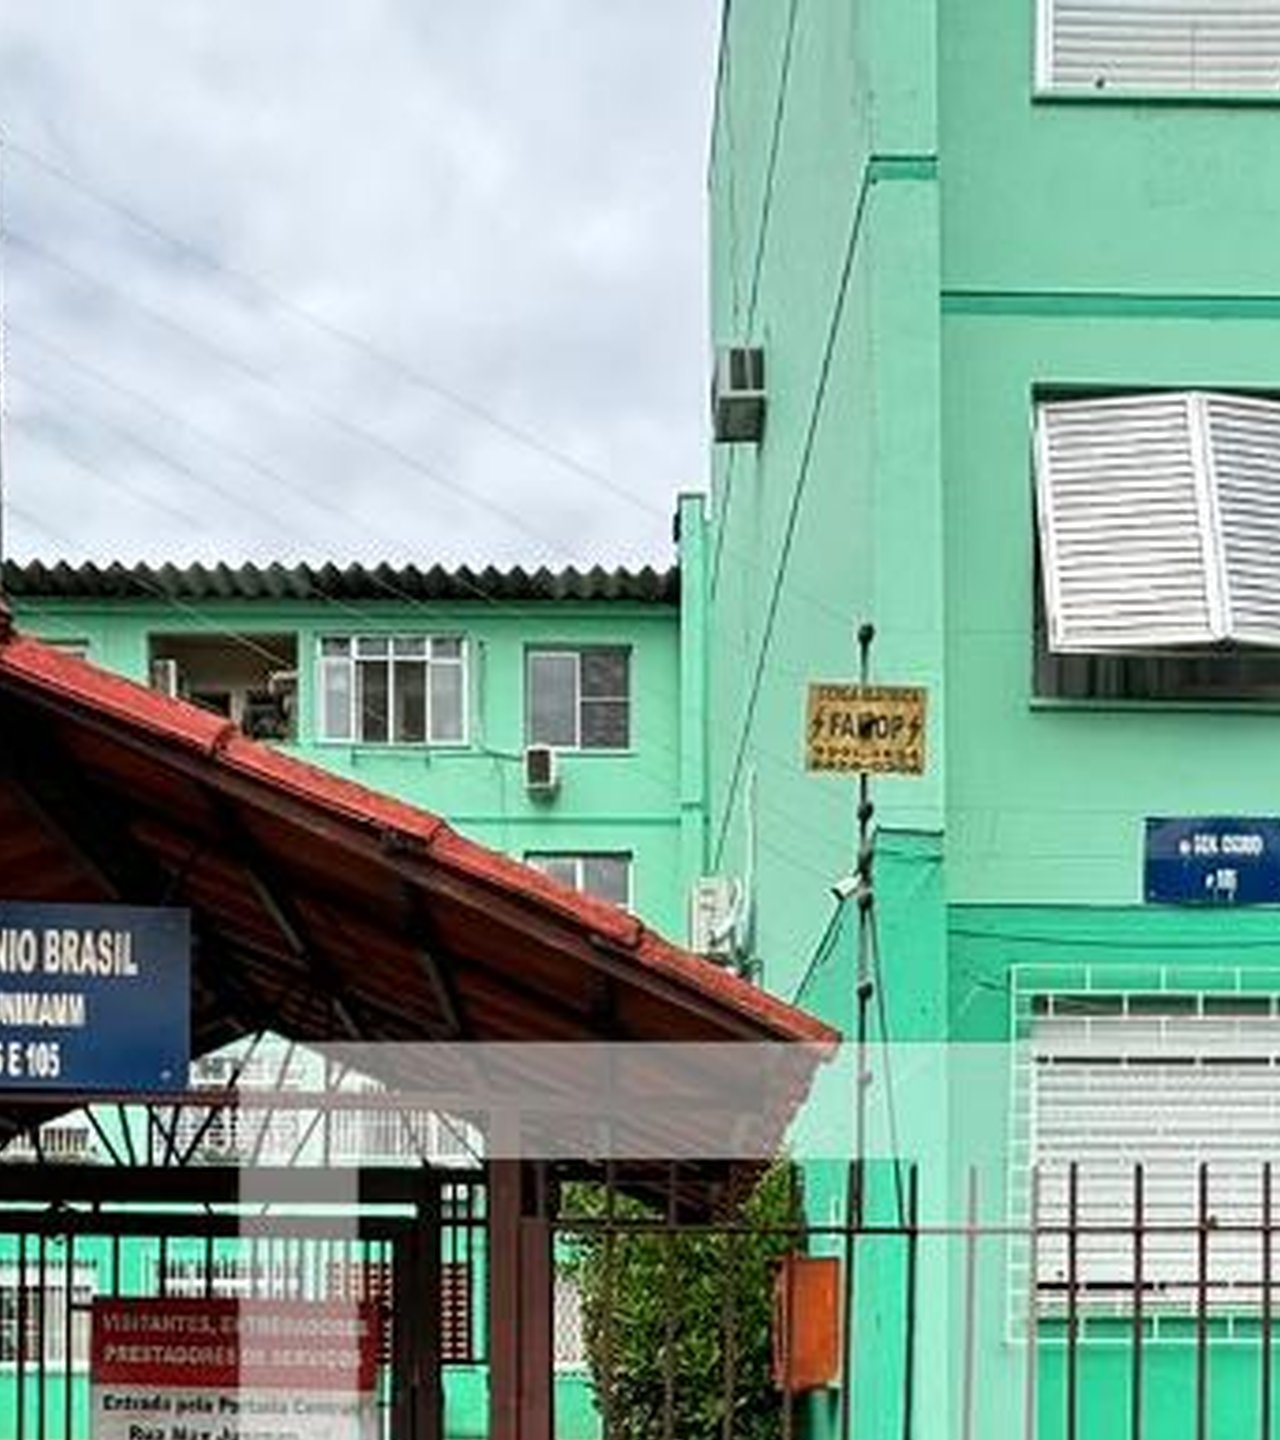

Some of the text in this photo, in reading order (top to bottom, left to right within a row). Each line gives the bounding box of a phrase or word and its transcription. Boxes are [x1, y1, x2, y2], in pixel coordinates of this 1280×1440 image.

[44, 928, 139, 977] BRASIL
[7, 1043, 23, 1078] E
[26, 1043, 61, 1079] 105
[103, 1345, 236, 1367] PRESTADORES
